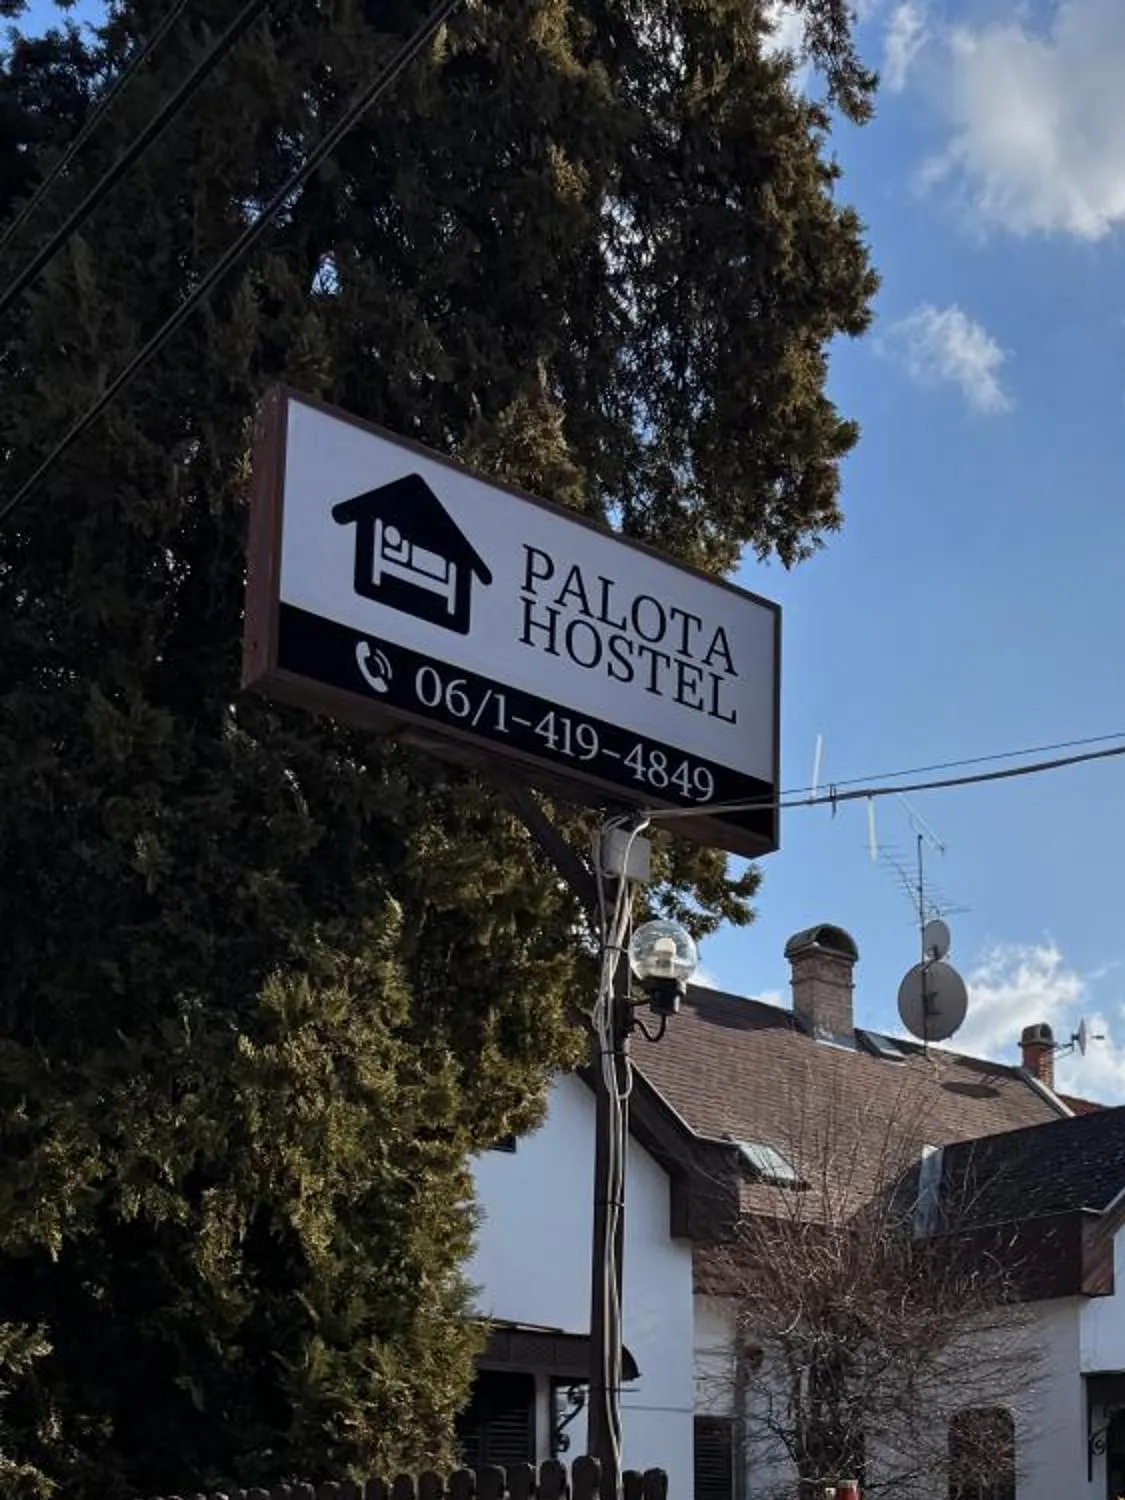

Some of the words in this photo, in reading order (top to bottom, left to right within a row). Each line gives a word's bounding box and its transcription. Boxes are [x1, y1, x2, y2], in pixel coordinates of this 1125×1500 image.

[518, 595, 737, 725] HOSTEL
[521, 543, 739, 677] PALOTA
[415, 665, 714, 801] 06/1-419-4849
